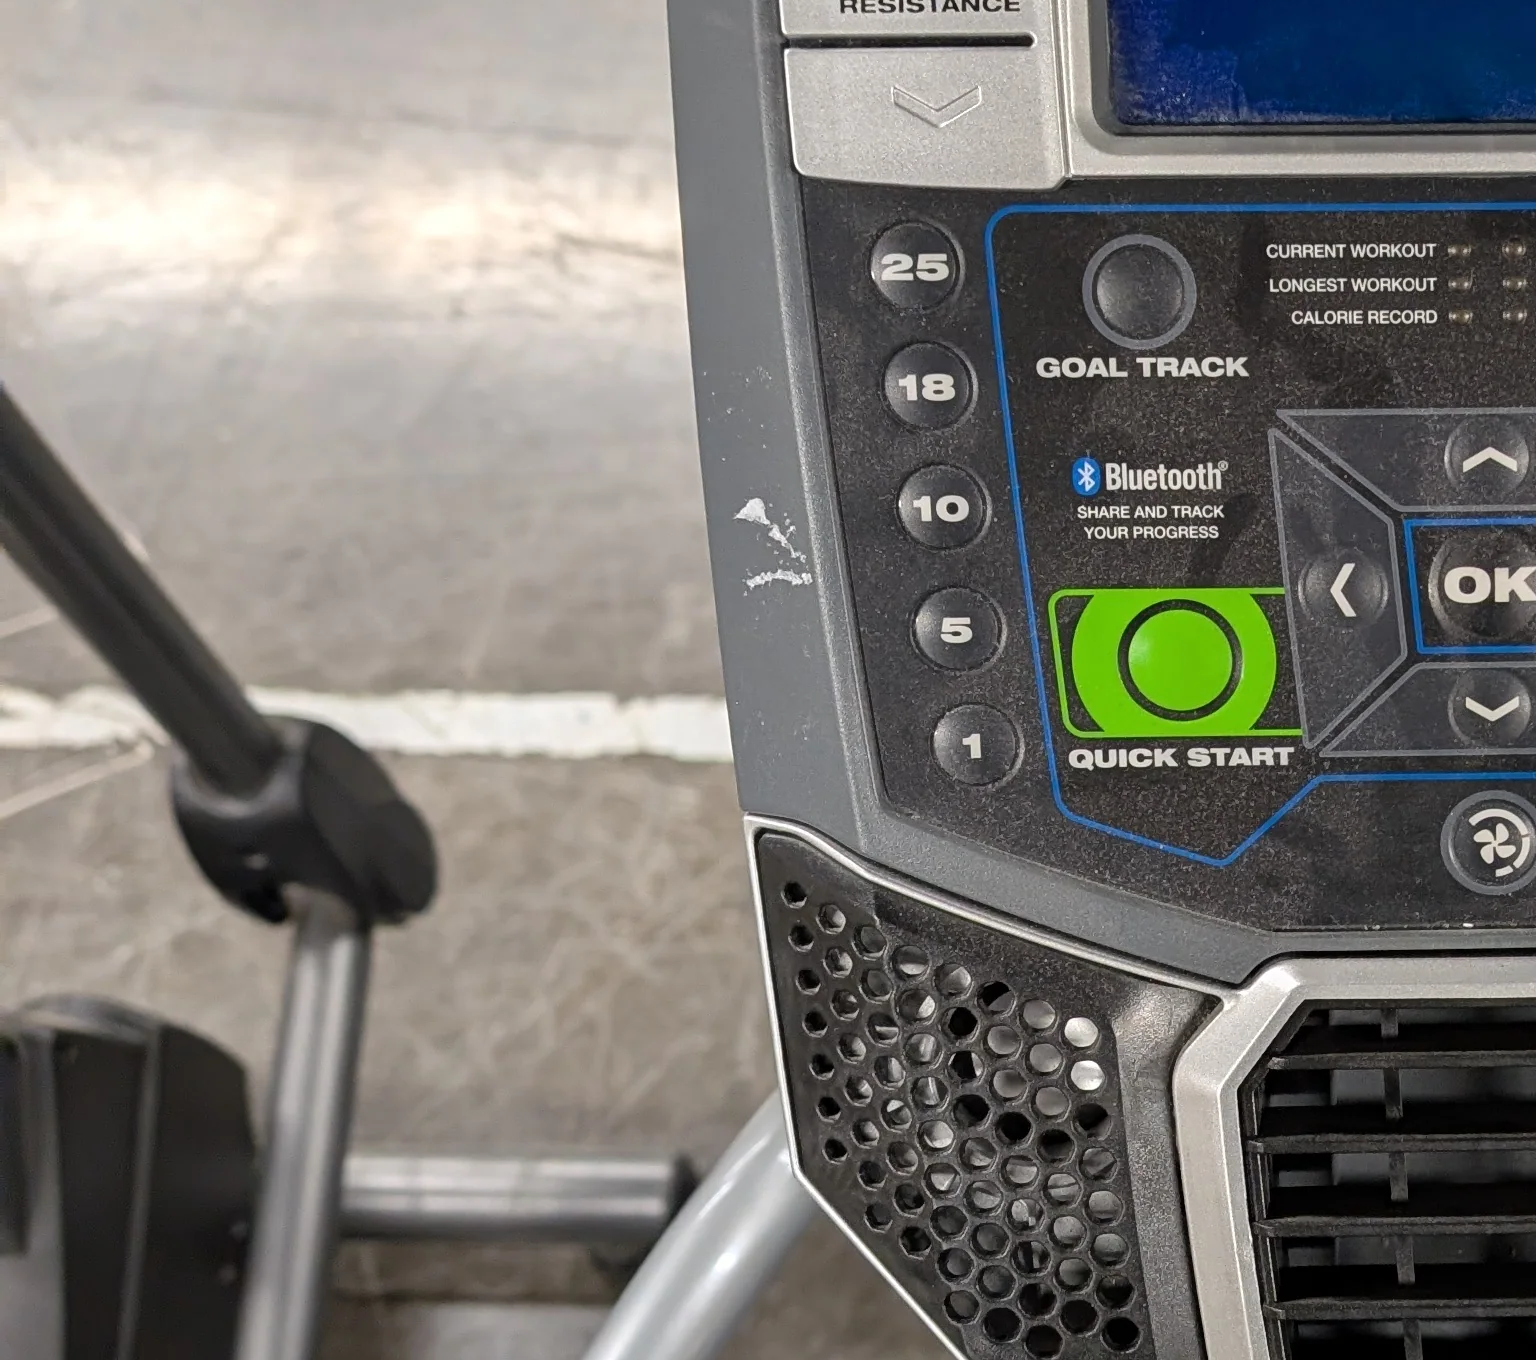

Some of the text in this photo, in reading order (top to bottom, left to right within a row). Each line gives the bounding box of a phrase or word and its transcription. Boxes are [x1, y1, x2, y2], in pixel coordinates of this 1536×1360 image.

[1265, 243, 1437, 259] CURRENT WORKOUT
[879, 253, 950, 283] 25
[1269, 277, 1438, 293] LONGEST WORKOUT
[1291, 309, 1438, 325] CALORIE RECORD
[1035, 356, 1250, 379] GOAL TRACK
[897, 373, 956, 402] 18
[911, 494, 970, 523] 10
[1077, 504, 1225, 519] SHARE AND TRACK
[1083, 525, 1220, 540] YOUR PROGRESS
[940, 617, 973, 644] 5
[962, 733, 982, 759] 1
[1068, 746, 1295, 771] QUICK START
